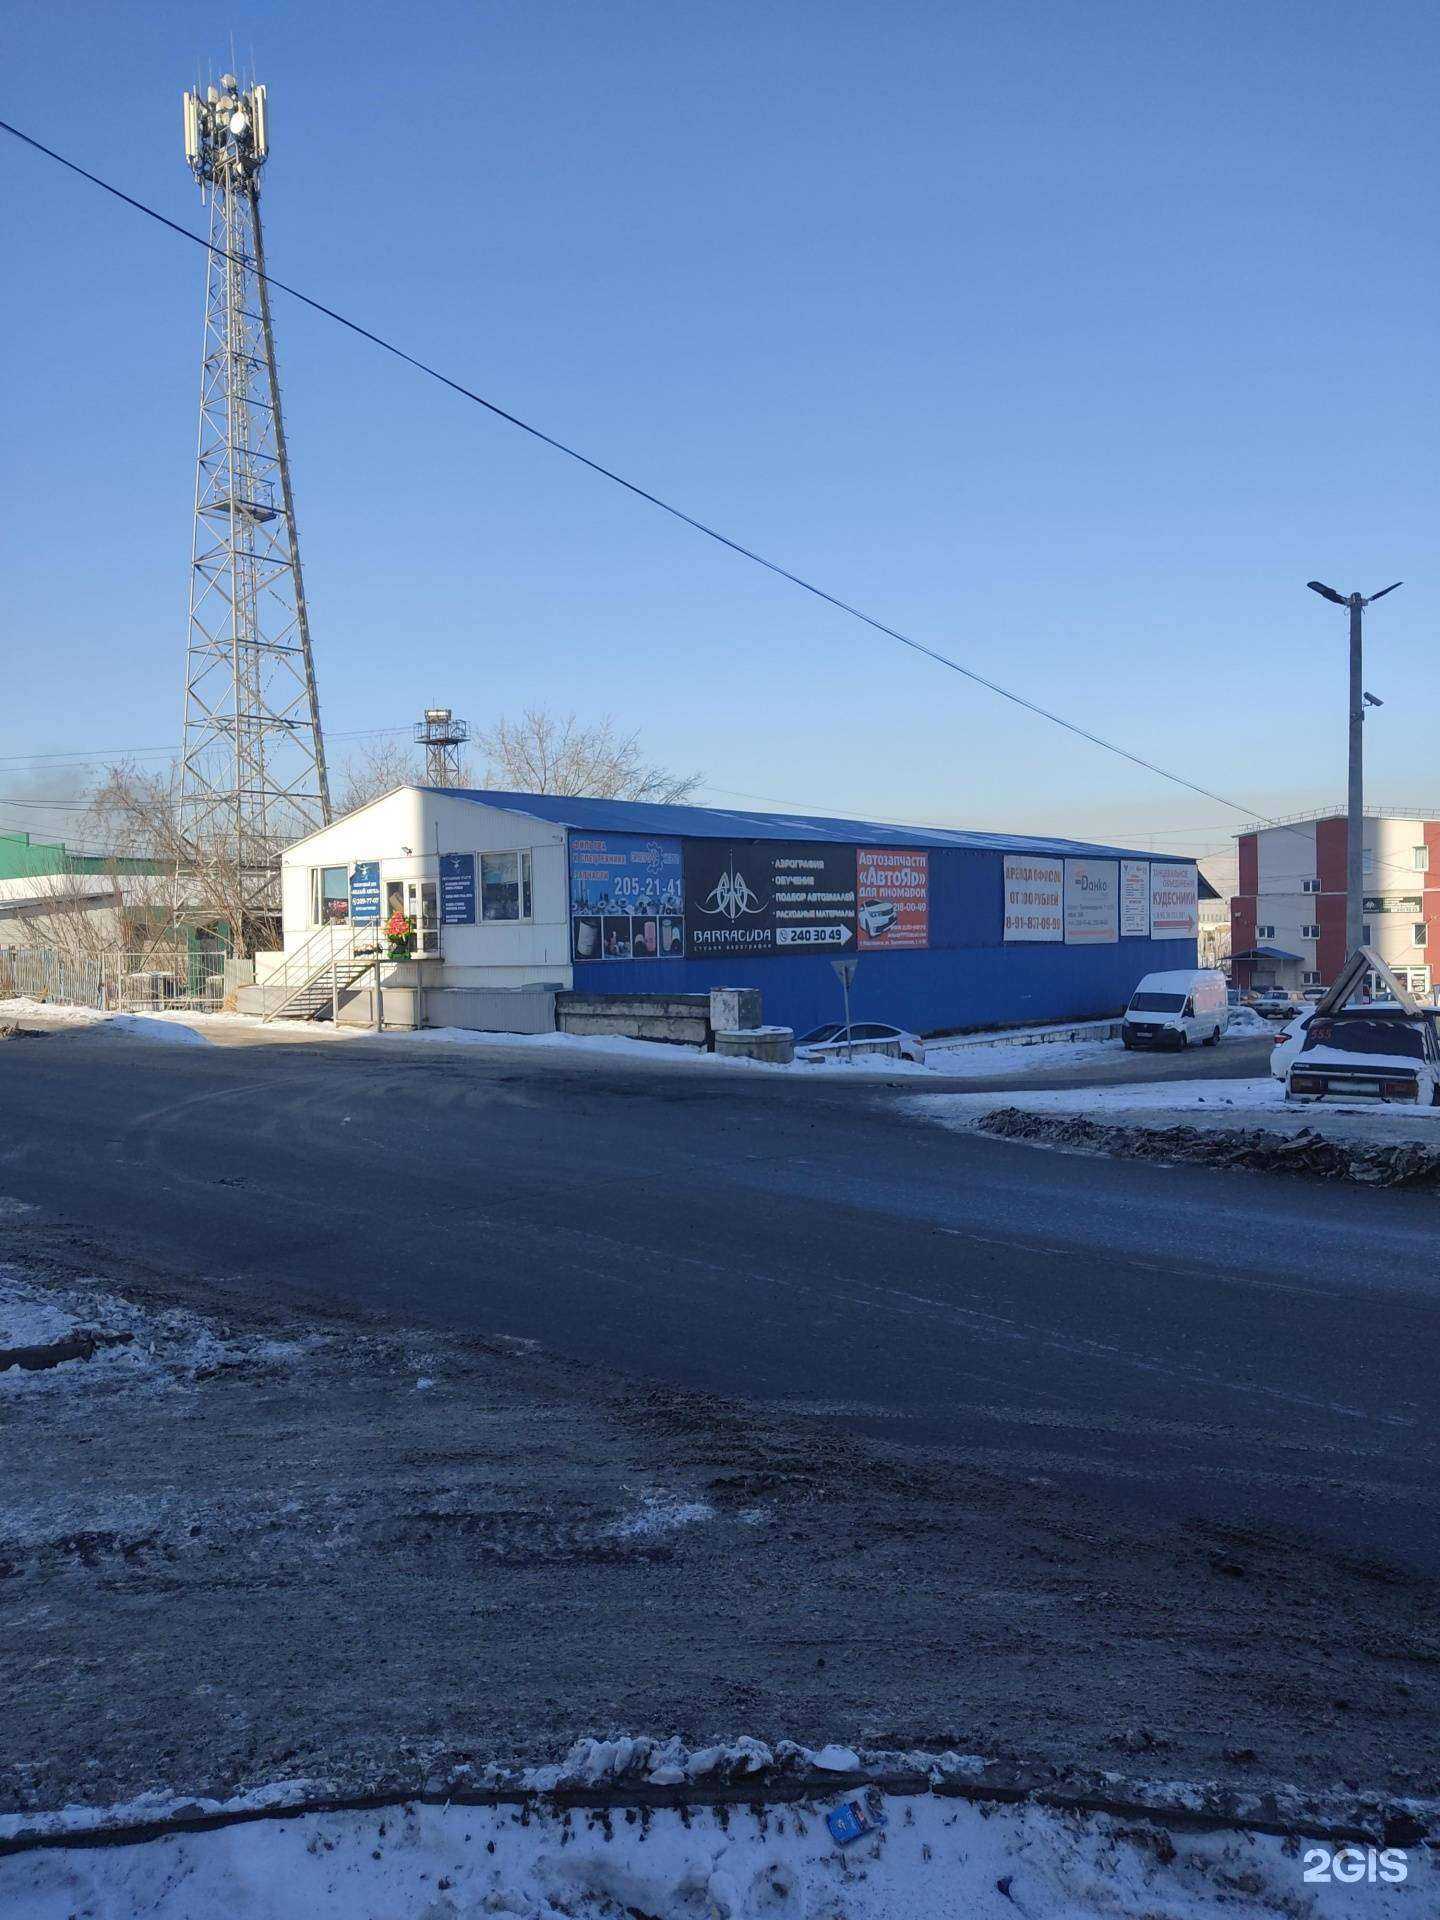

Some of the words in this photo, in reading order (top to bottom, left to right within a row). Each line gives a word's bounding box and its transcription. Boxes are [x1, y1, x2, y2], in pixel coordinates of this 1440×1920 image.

[860, 852, 926, 867] Автозапчасти
[613, 877, 682, 896] 205-21-41
[879, 887, 926, 898] иномарок
[694, 929, 772, 944] BARRACUDA
[791, 931, 811, 942] 240
[814, 930, 826, 942] 30
[829, 929, 842, 941] 49
